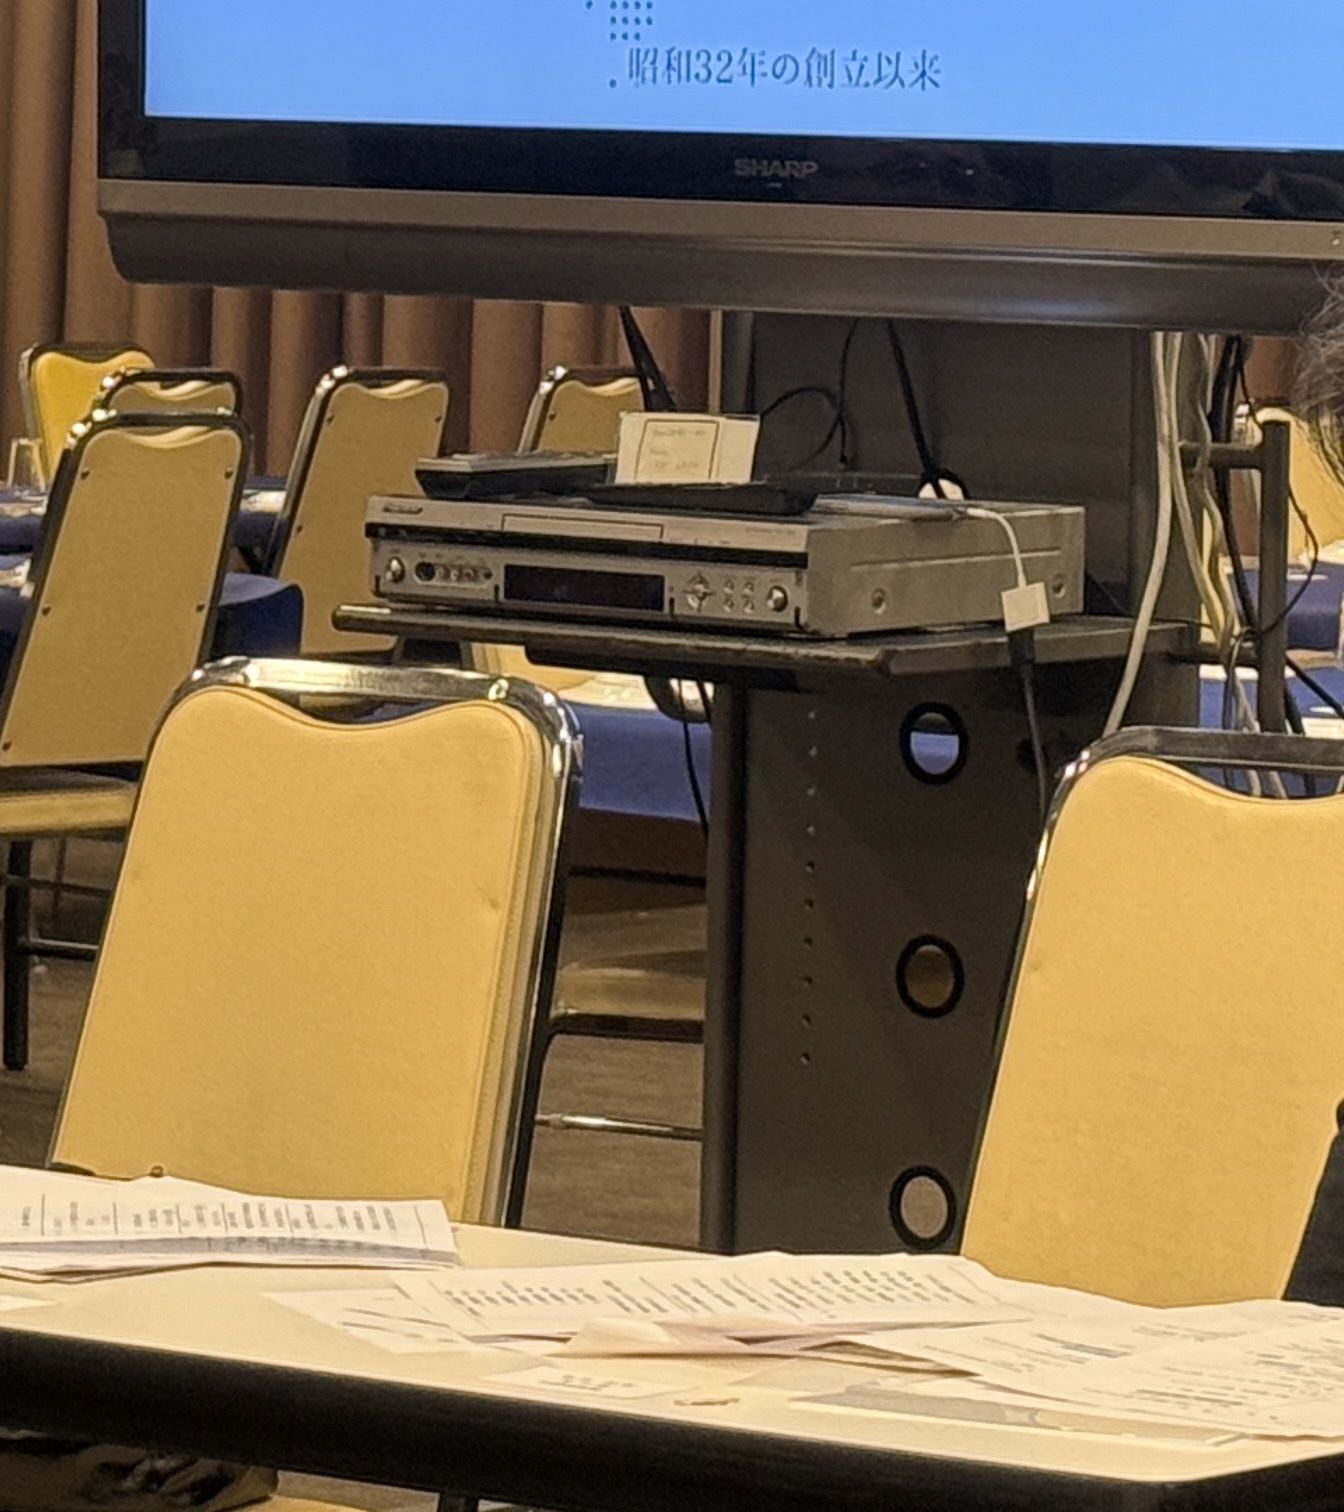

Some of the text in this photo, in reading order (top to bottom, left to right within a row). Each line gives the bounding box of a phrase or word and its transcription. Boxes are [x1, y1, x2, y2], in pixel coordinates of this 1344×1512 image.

[628, 46, 942, 91] 昭和32年の創立以来
[734, 158, 818, 179] SHARP
